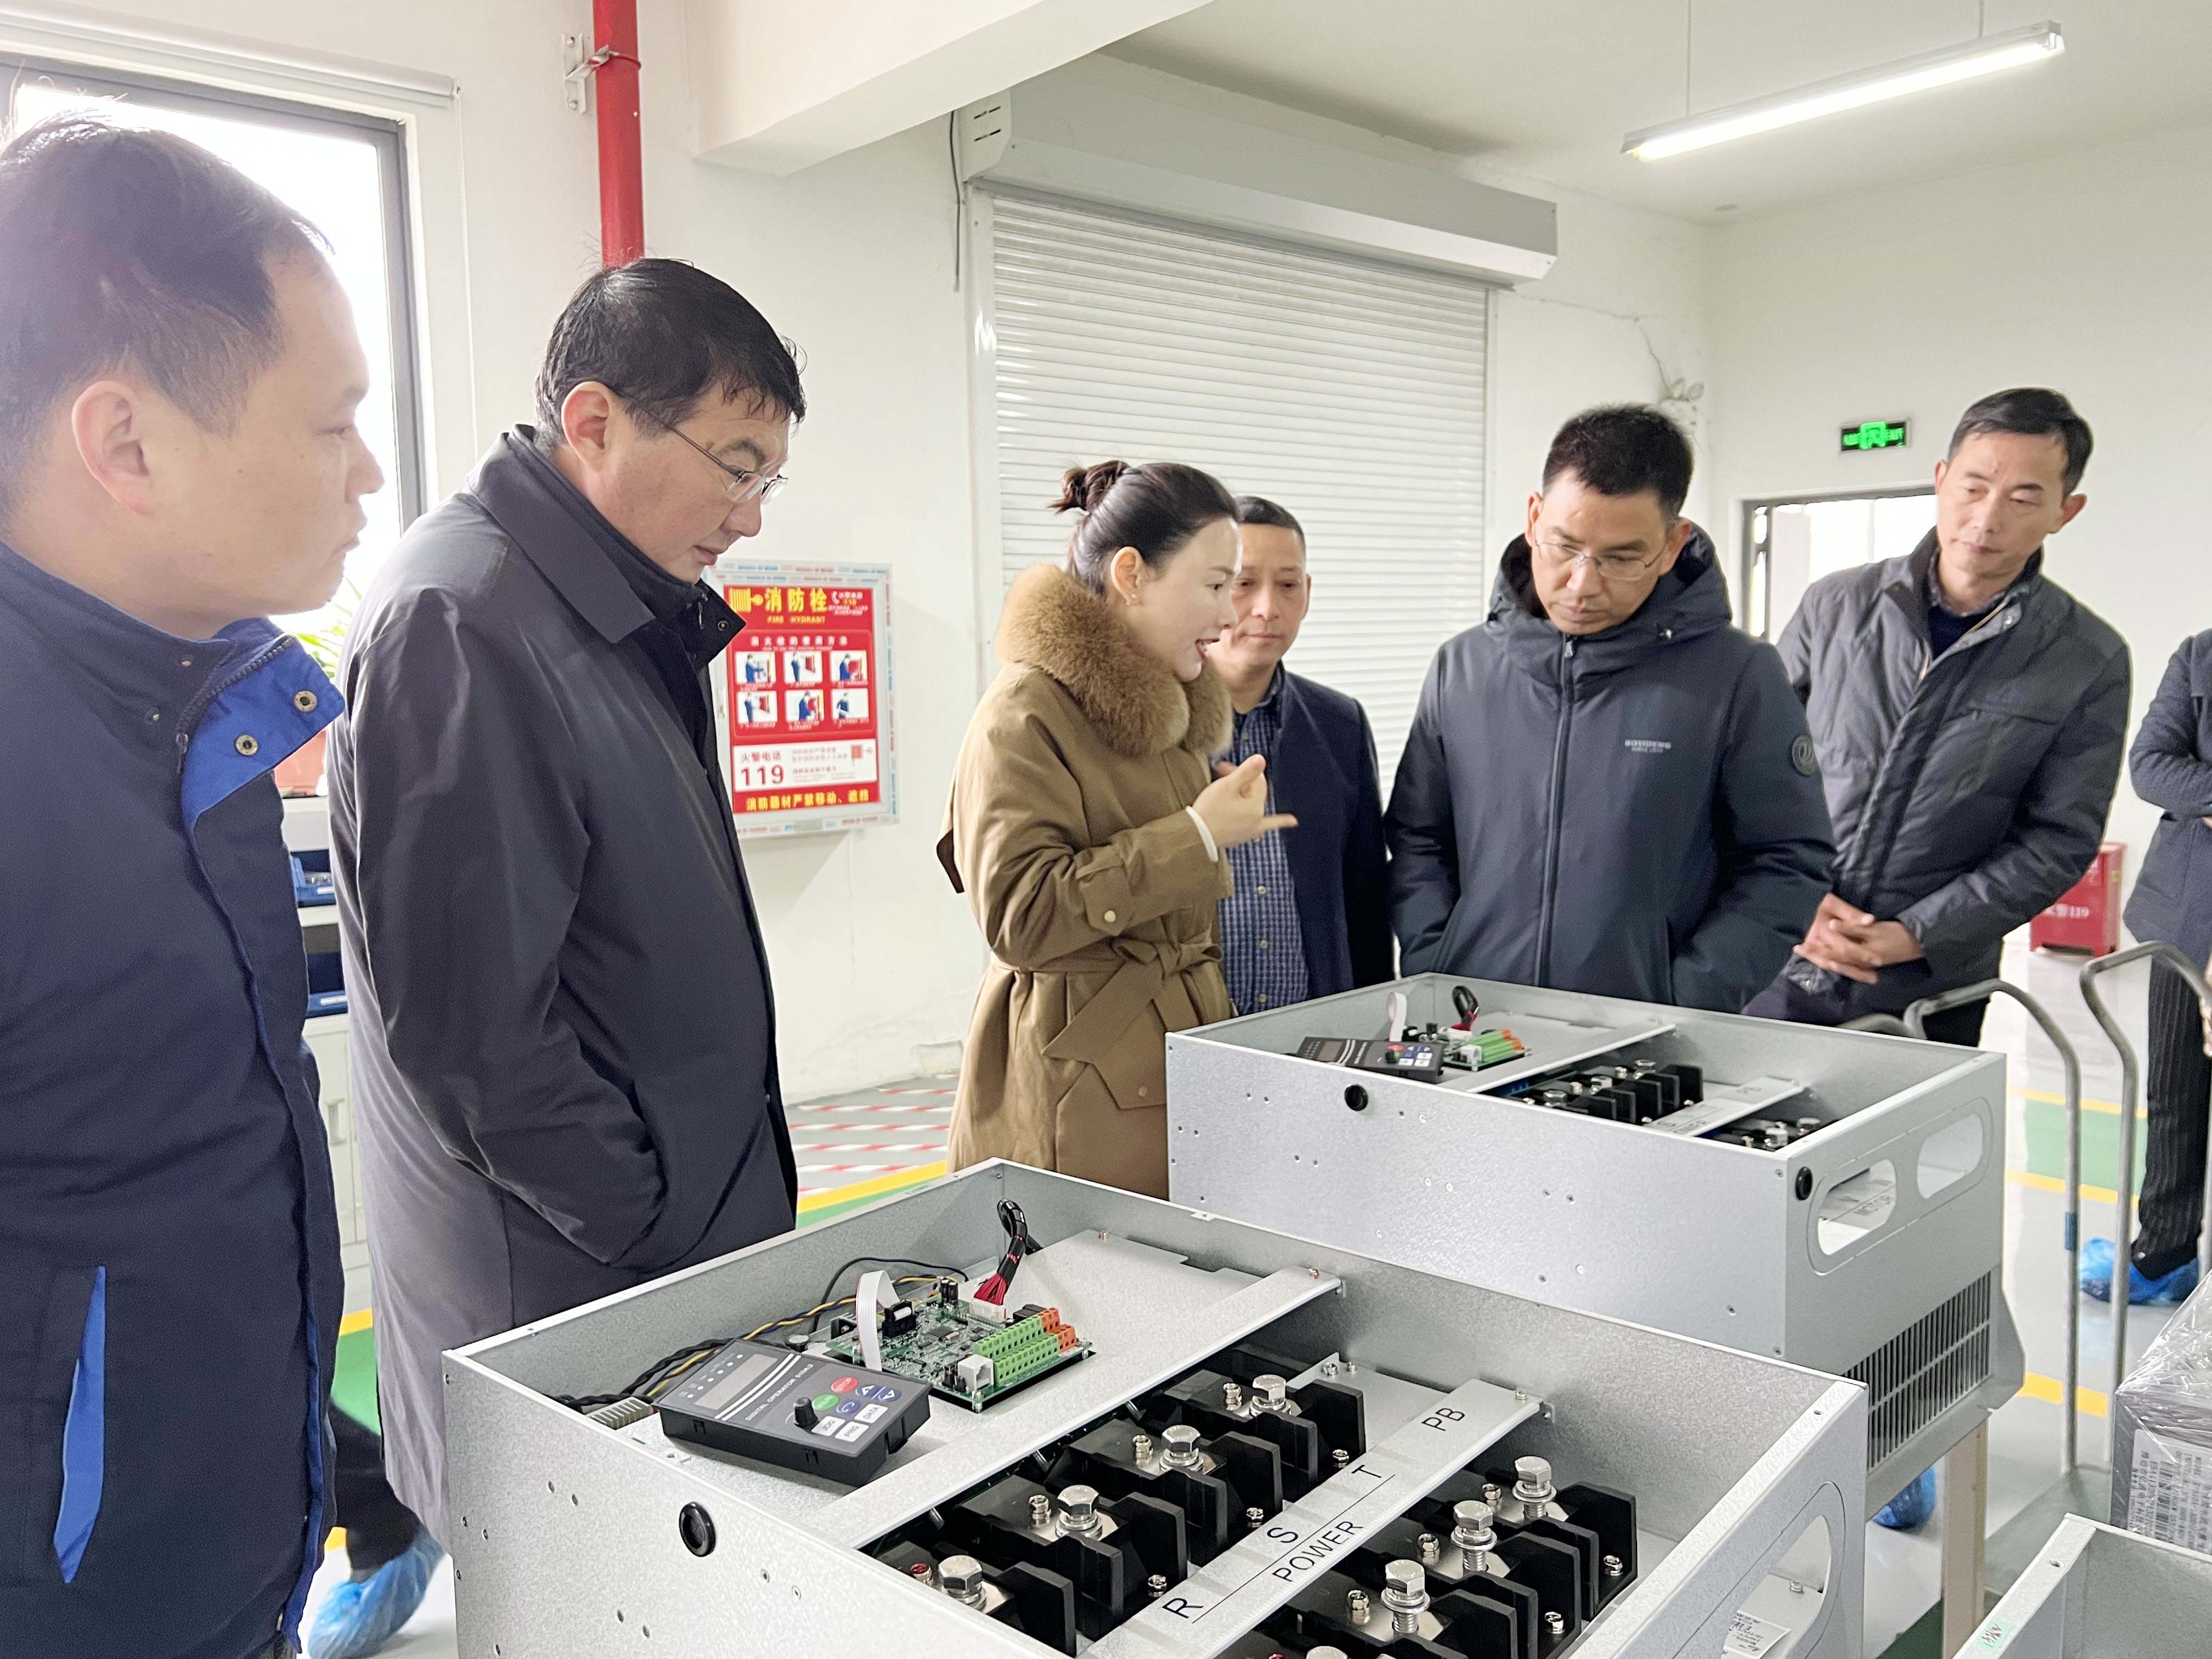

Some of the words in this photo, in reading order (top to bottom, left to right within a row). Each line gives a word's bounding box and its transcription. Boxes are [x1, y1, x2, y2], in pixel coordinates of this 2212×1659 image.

[765, 587, 827, 612] 消防栓
[741, 750, 781, 763] 火警电话
[741, 764, 785, 786] 119
[745, 1404, 769, 1420] DIGITAL
[767, 1378, 795, 1402] OPERATOR
[863, 1407, 879, 1419] DATA
[823, 1420, 836, 1431] JOG
[844, 1425, 860, 1437] PRG
[1161, 1597, 1204, 1619] R
[1267, 1526, 1299, 1544] S
[1351, 1464, 1382, 1479] T
[1421, 1407, 1465, 1431] PB
[1272, 1520, 1364, 1582] POWER
